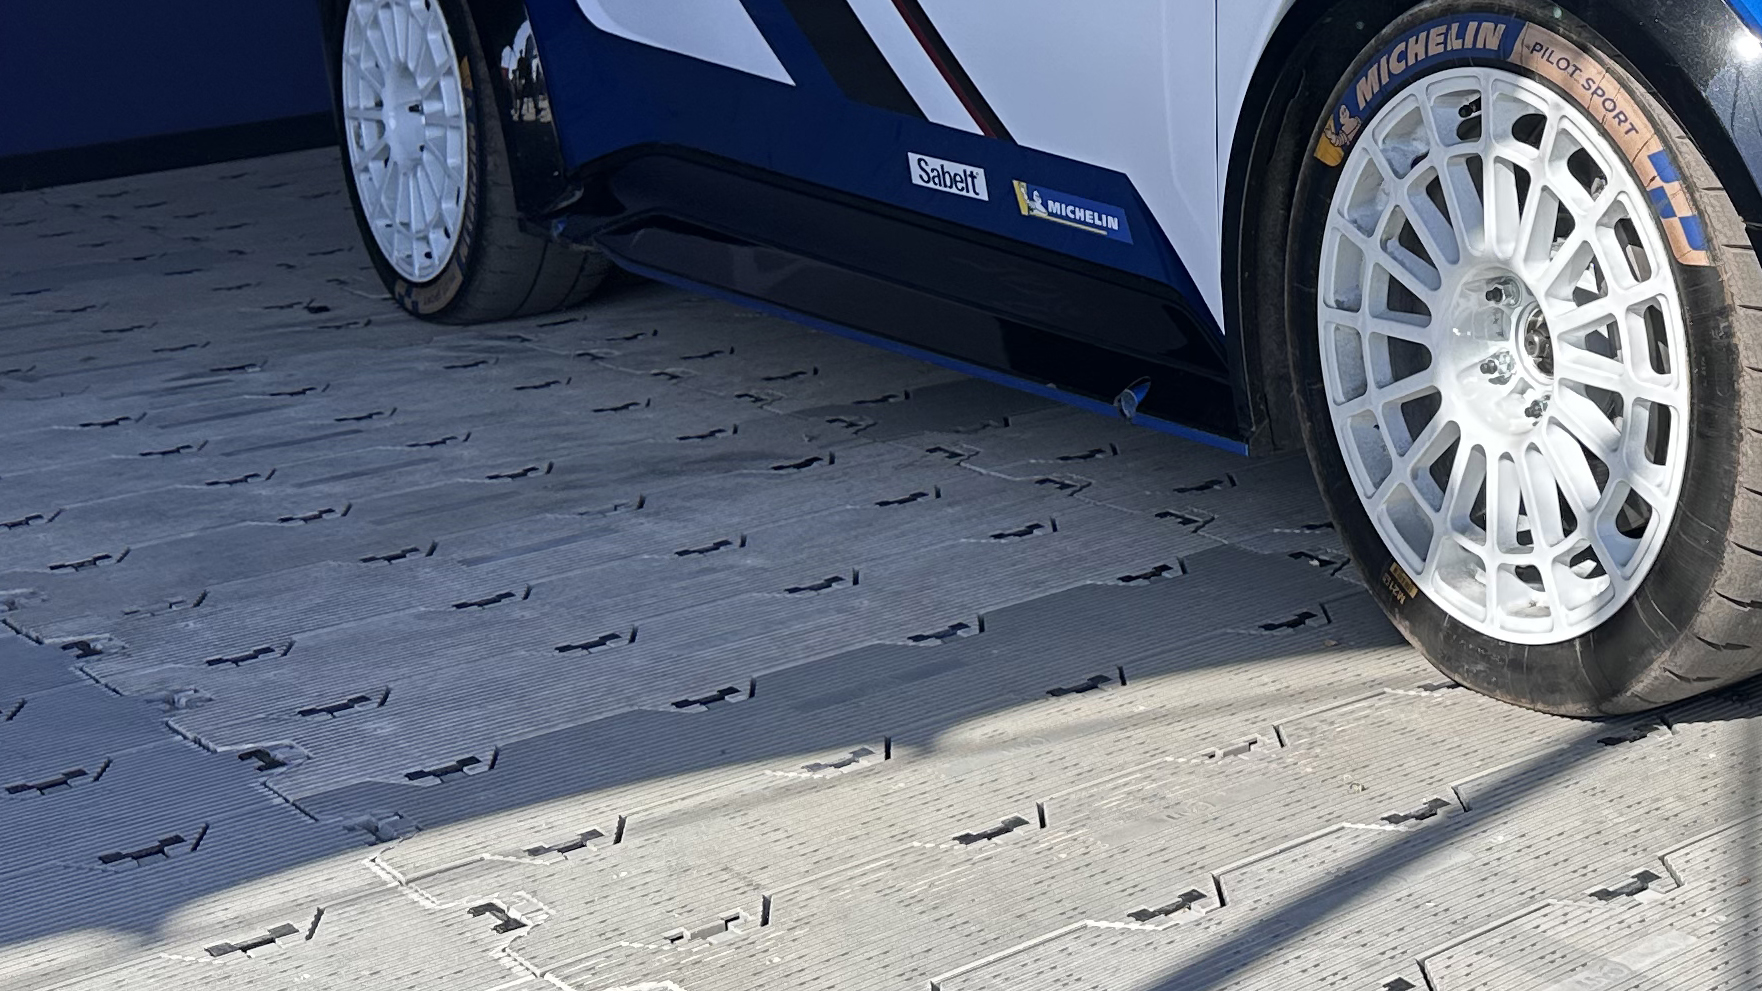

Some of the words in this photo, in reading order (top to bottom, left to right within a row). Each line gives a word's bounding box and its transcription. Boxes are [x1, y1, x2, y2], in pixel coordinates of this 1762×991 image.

[1355, 20, 1507, 111] MICHELIN
[1530, 40, 1582, 78] PILOT
[1581, 76, 1640, 136] SPORT
[916, 157, 980, 196] Sabelt
[1047, 199, 1120, 231] MICHELIN
